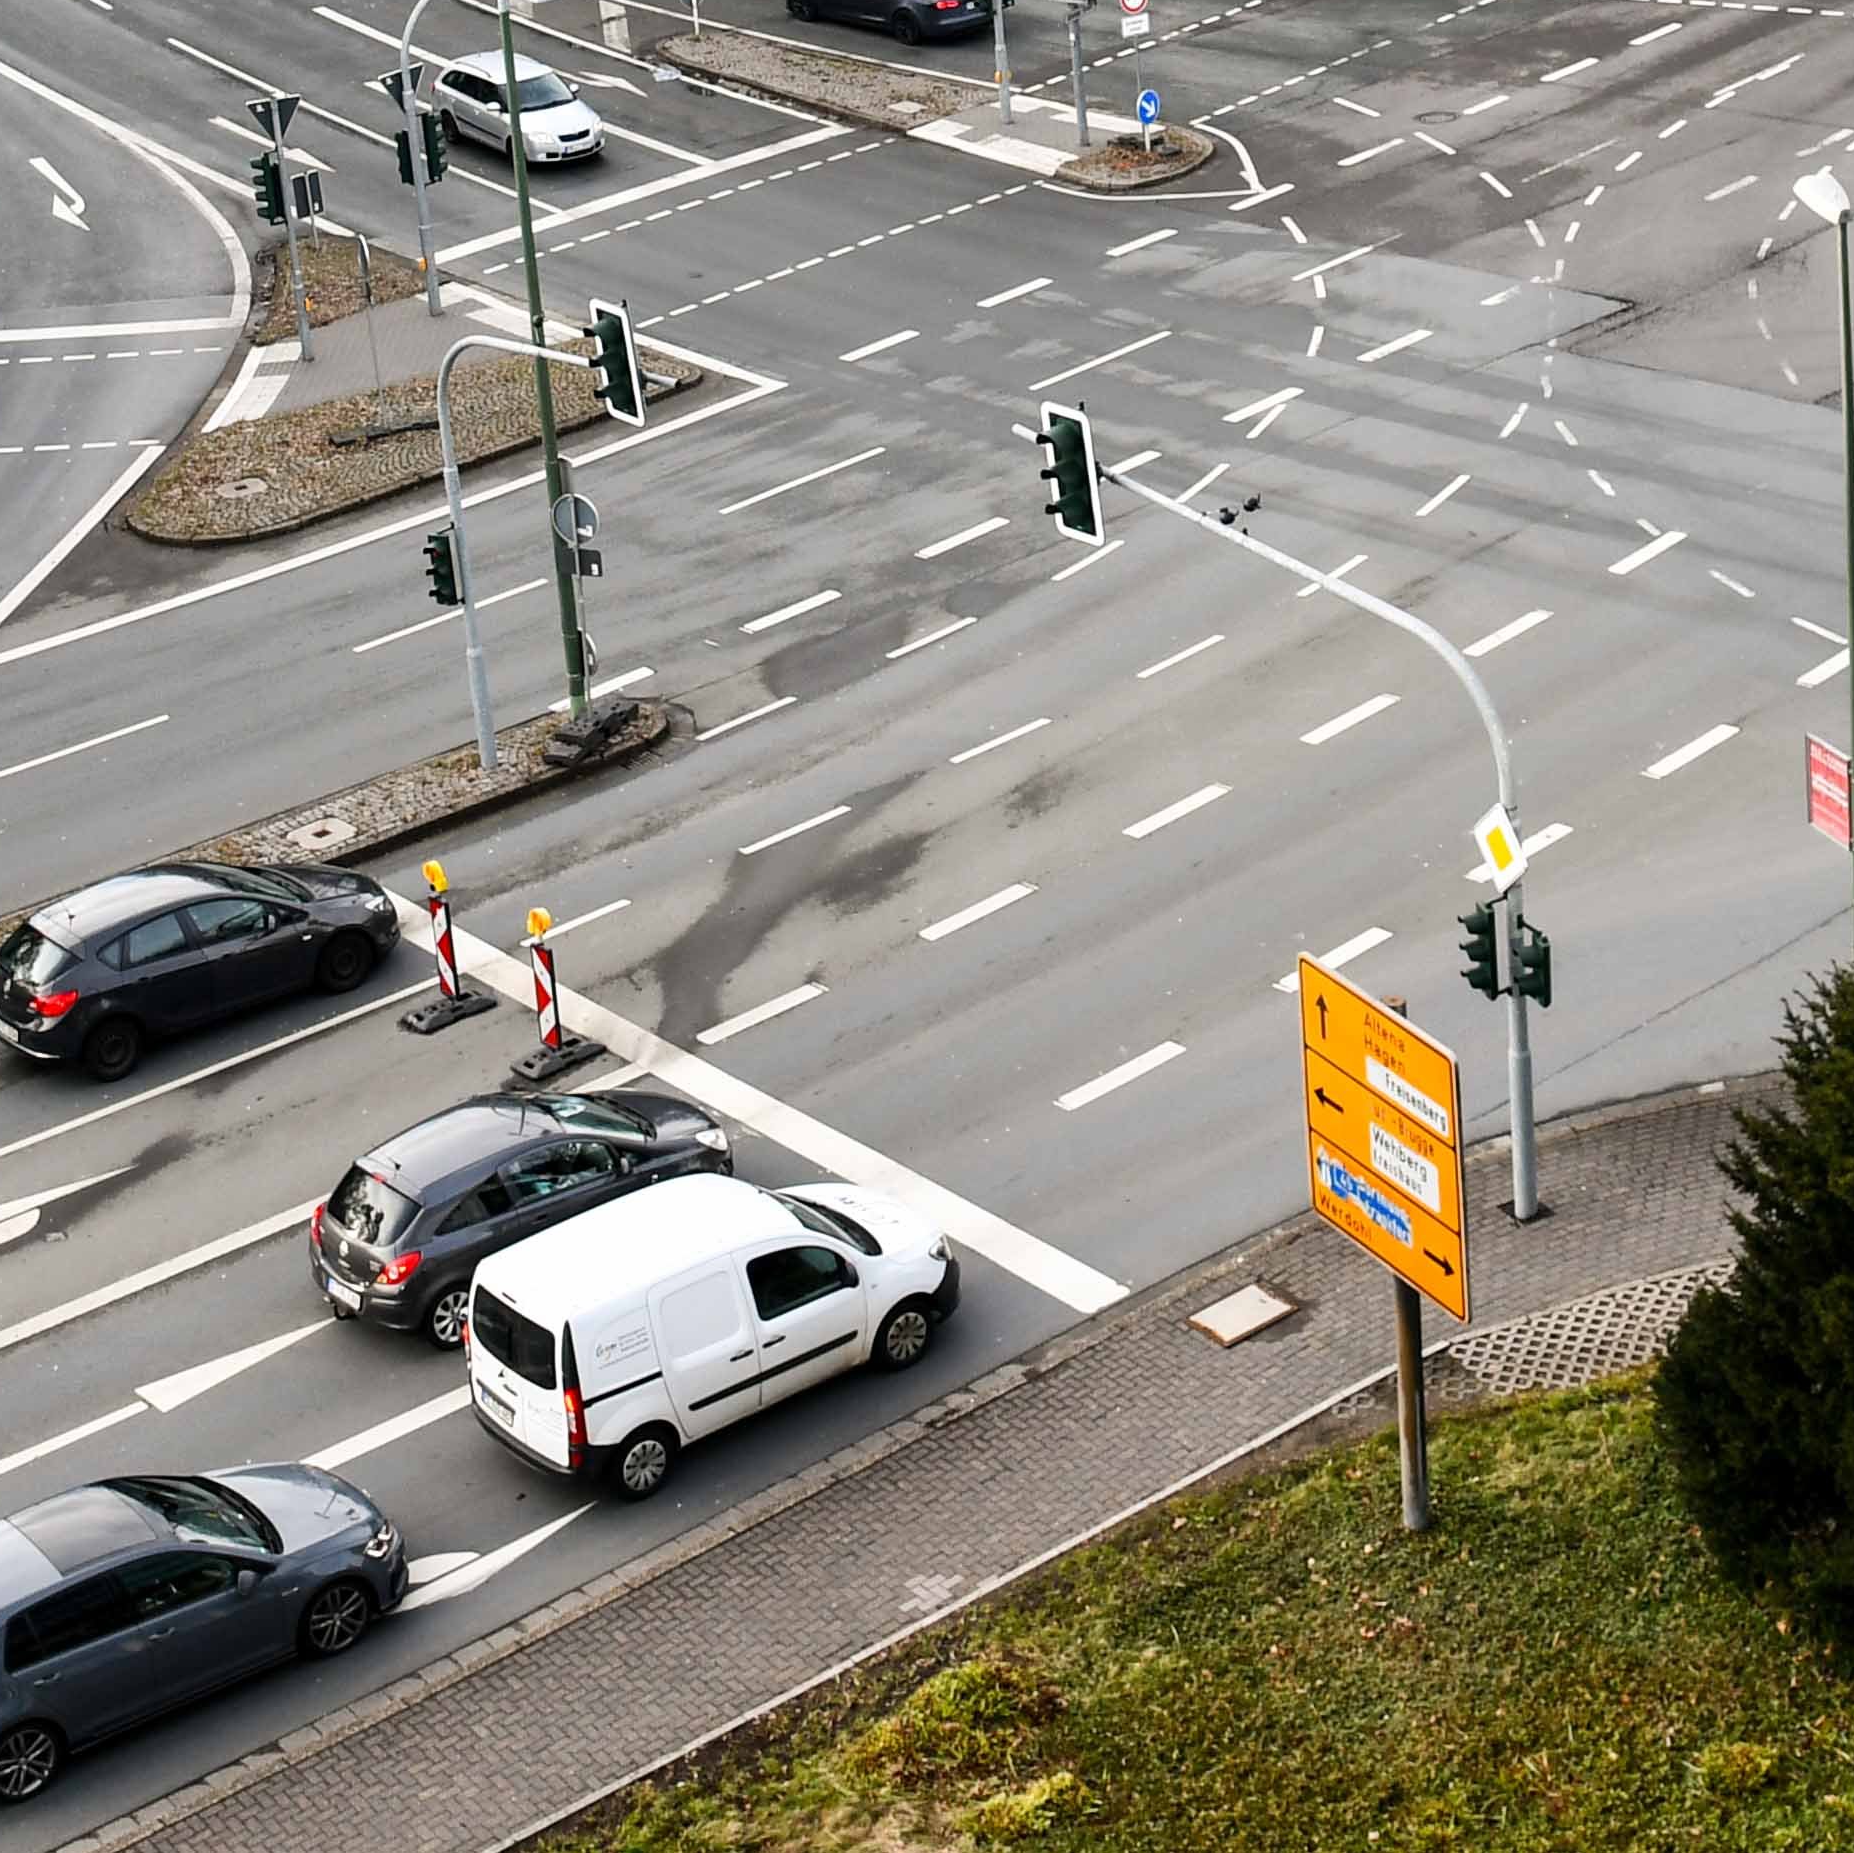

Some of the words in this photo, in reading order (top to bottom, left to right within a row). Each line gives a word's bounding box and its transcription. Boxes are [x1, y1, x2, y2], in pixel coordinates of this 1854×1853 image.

[1363, 1011, 1406, 1054] Altena
[1363, 1034, 1406, 1076] Hagen
[1385, 1072, 1447, 1132] Freisenberg
[1371, 1126, 1428, 1183] Wehberg
